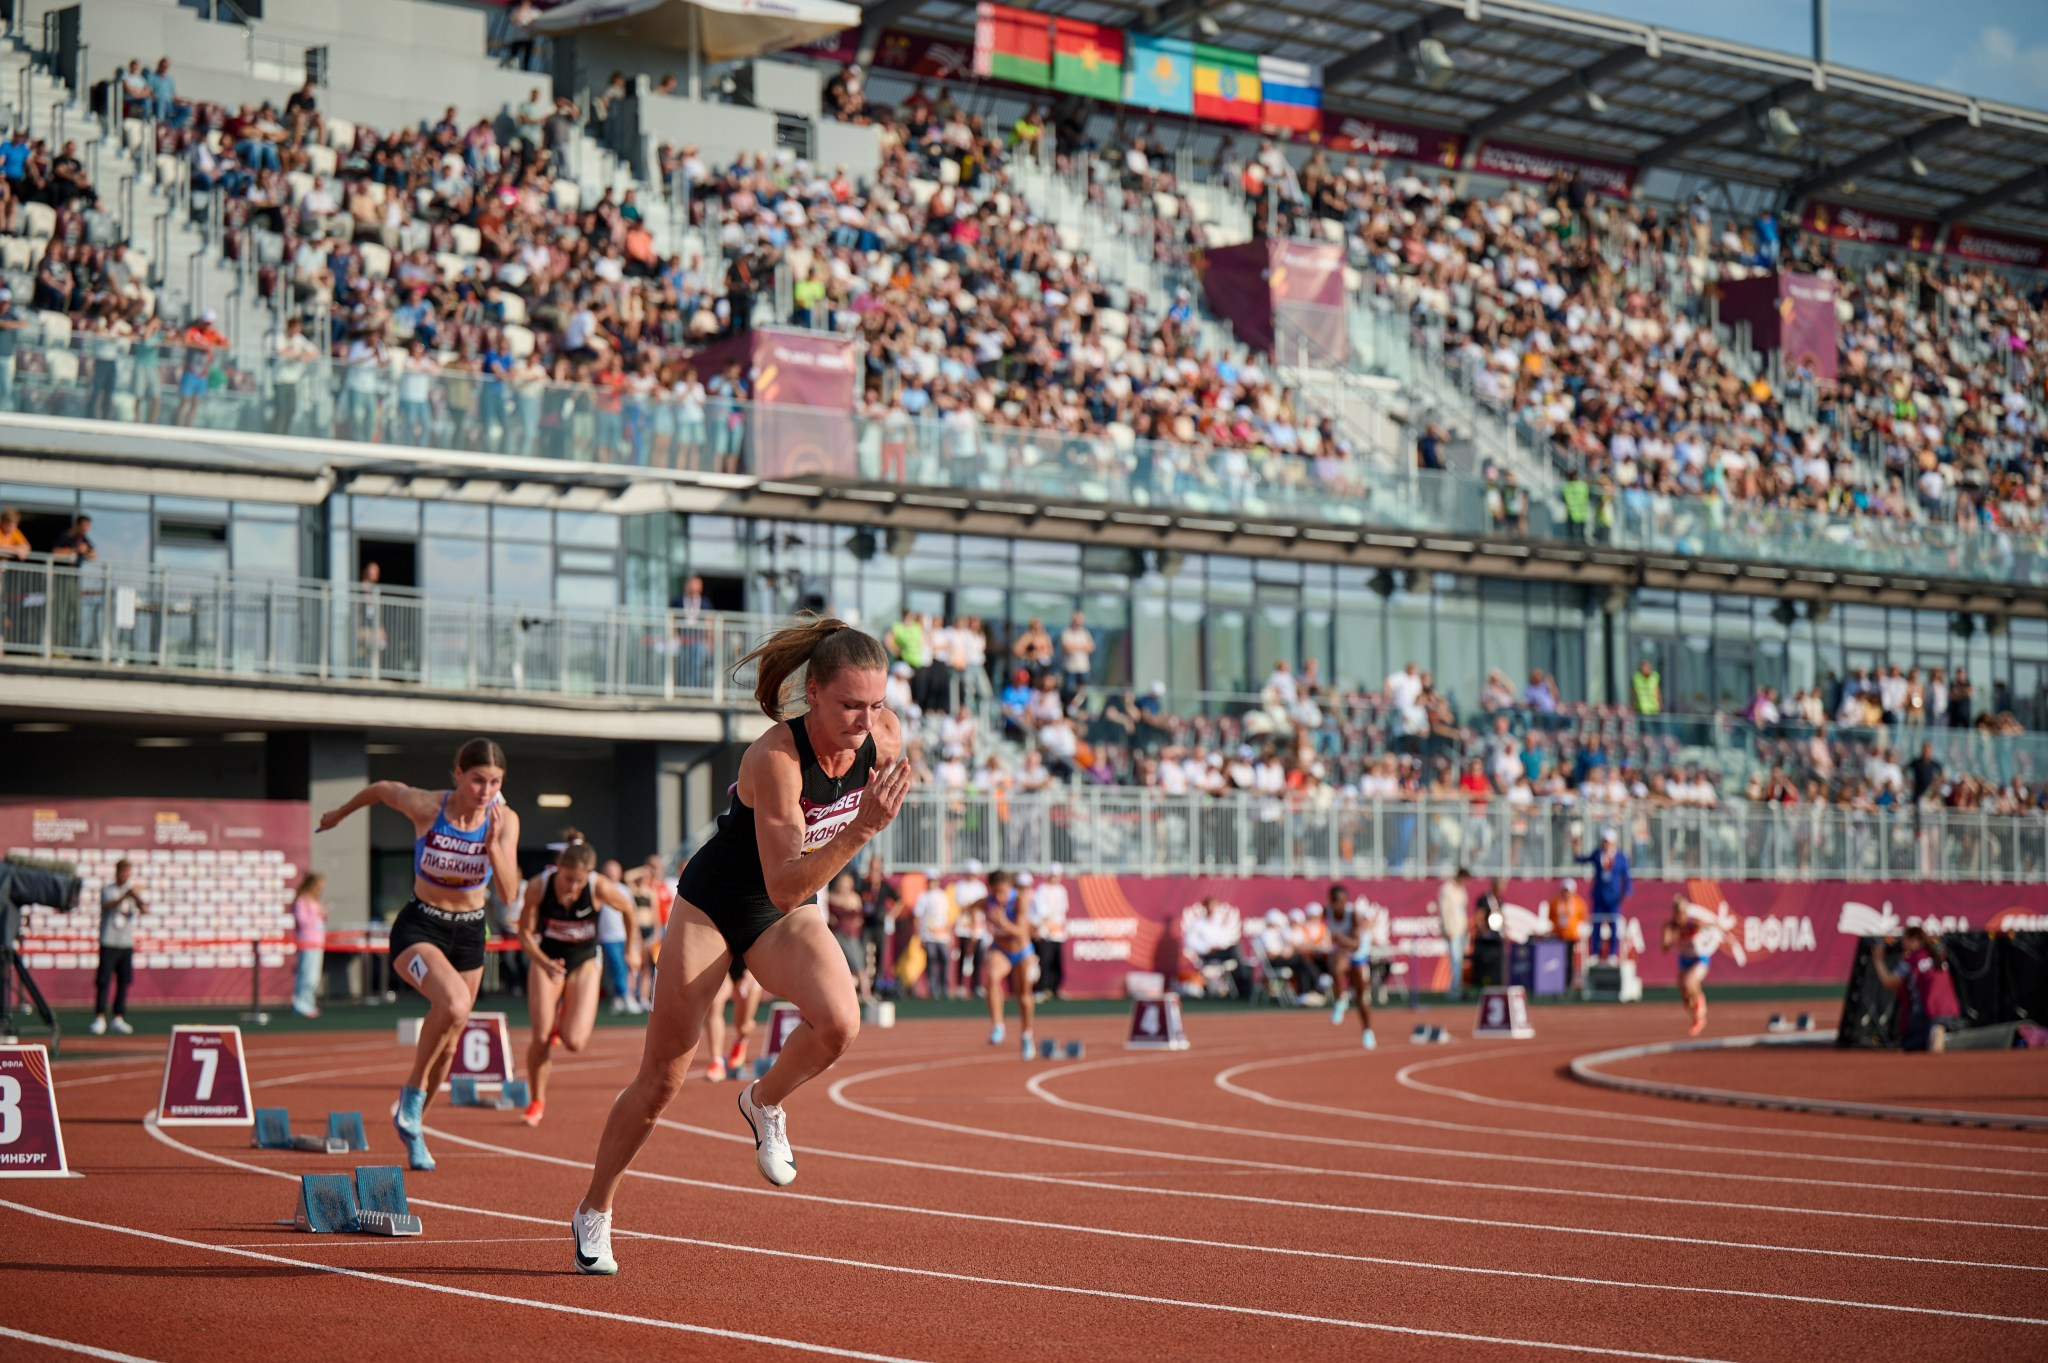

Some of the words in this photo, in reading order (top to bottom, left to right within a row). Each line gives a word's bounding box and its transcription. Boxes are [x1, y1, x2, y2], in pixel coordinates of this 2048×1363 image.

[805, 790, 864, 819] FONBET
[432, 834, 485, 854] FONBET
[423, 852, 485, 875] ЛИЗЯКИНА
[417, 903, 453, 921] NIKE
[454, 909, 485, 922] PRO
[410, 960, 421, 978] 7
[1140, 1005, 1160, 1034] 4
[1487, 996, 1505, 1026] 3
[463, 1028, 490, 1072] 6
[192, 1048, 219, 1100] 7
